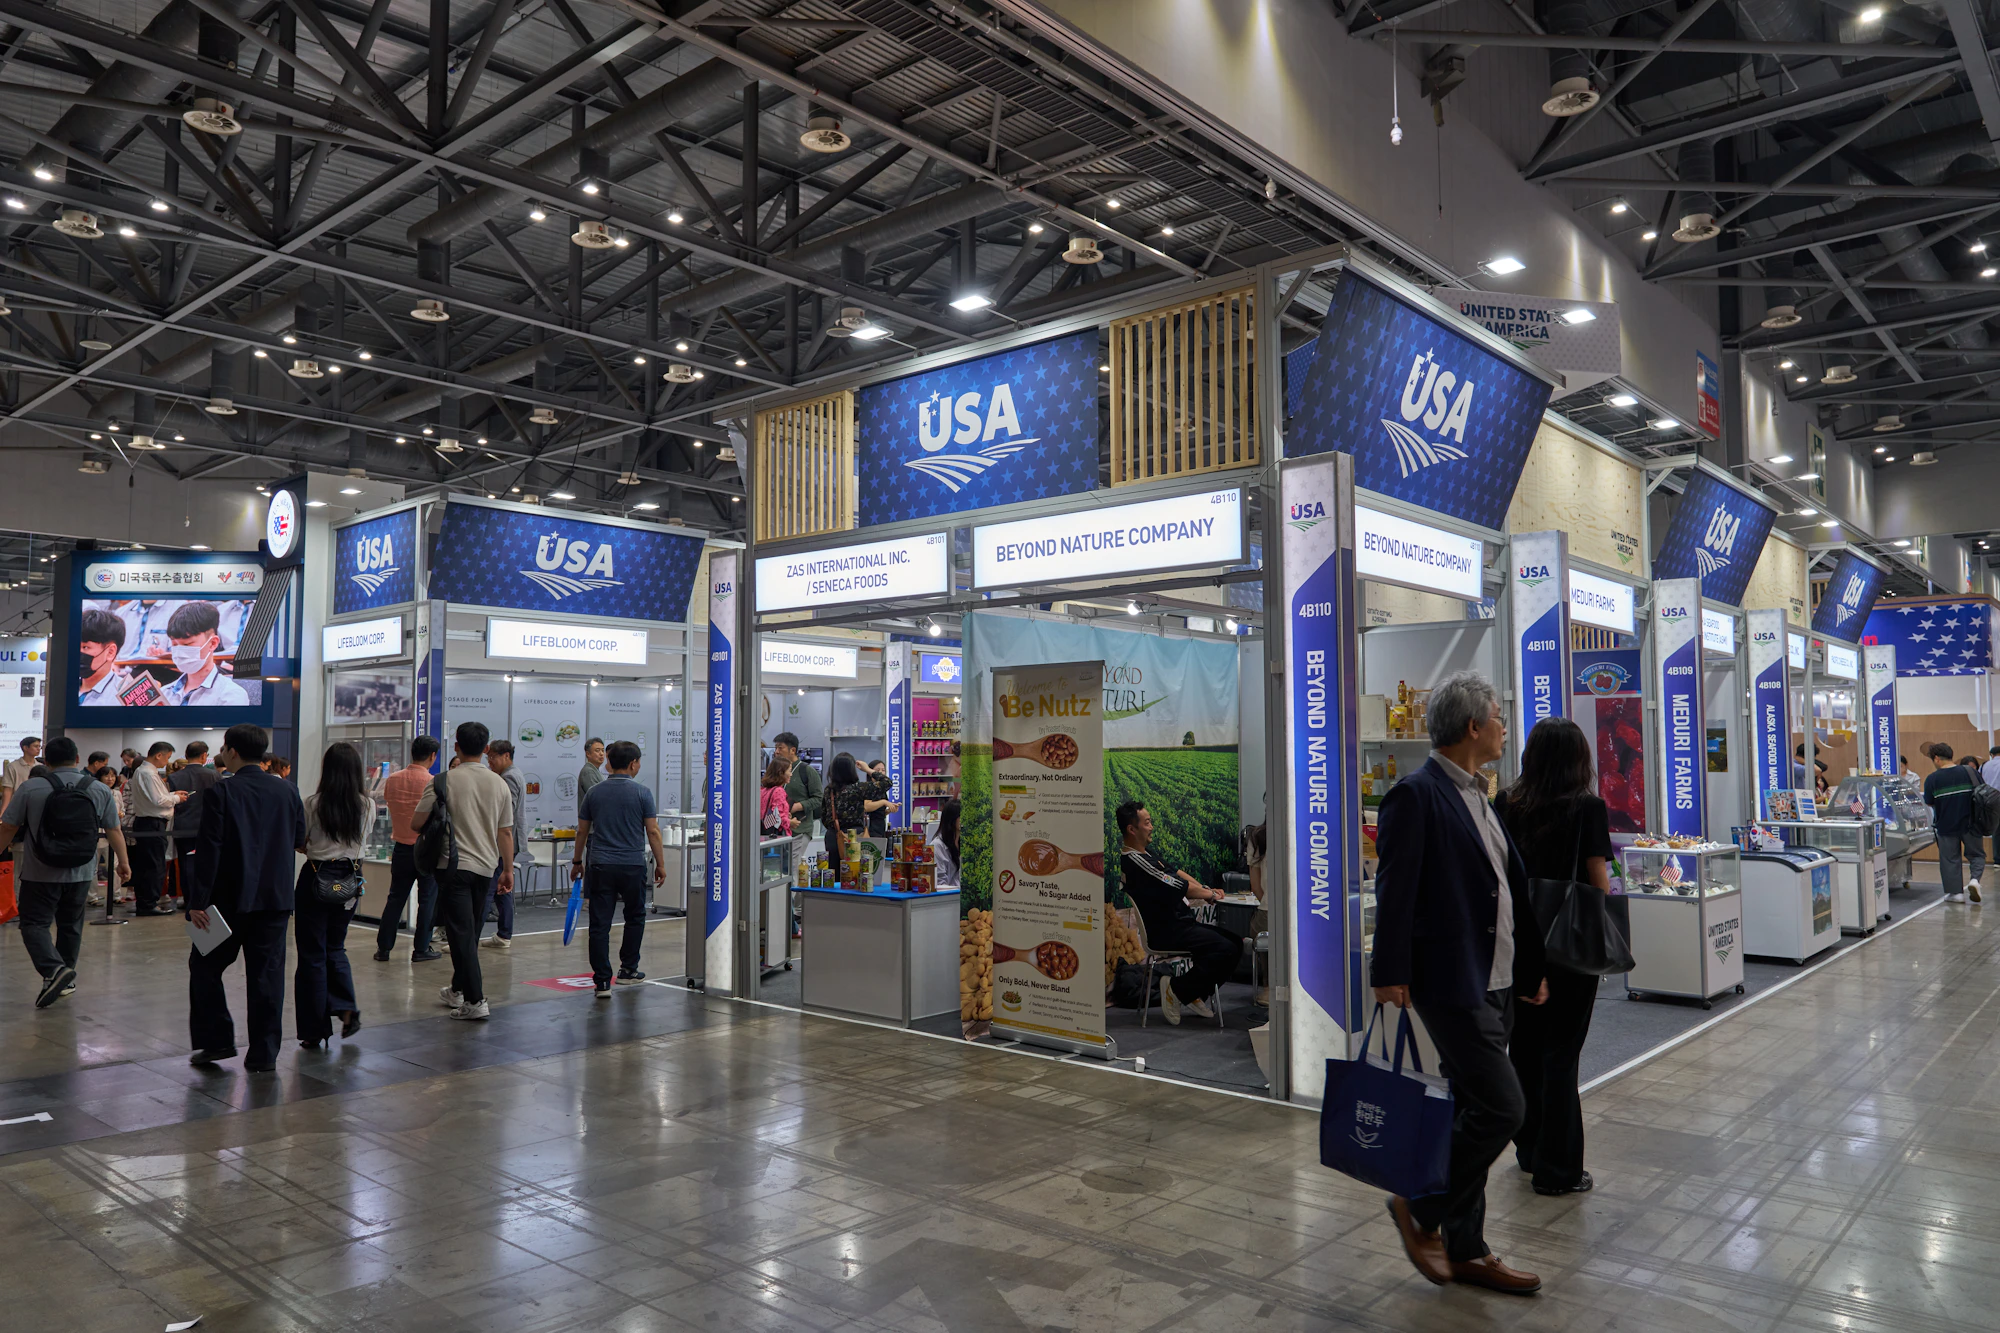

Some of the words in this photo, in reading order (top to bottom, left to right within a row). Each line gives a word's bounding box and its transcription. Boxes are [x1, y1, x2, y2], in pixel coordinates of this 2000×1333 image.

[1460, 302, 1516, 319] UNITED
[1519, 307, 1550, 322] STAT
[1401, 350, 1474, 444] USA
[918, 383, 1022, 452] USA
[1210, 492, 1237, 505] 4B110
[1290, 502, 1326, 520] USA
[1611, 530, 1625, 543] UNITED
[1625, 534, 1639, 548] STATES
[1704, 502, 1741, 556] USA
[926, 535, 945, 545] 4B101
[996, 539, 1057, 562] BEYOND
[1060, 530, 1124, 554] NATURE
[1128, 517, 1214, 545] COMPANY
[356, 534, 394, 572] USA
[534, 532, 614, 578] USA
[1364, 531, 1400, 557] BEYOND
[1401, 541, 1434, 565] NATURE
[1435, 550, 1472, 574] COMPANY
[786, 564, 805, 578] ZAS
[806, 553, 887, 575] INTERNATIONAL
[889, 550, 910, 565] INC.
[1519, 565, 1550, 578] USA
[119, 571, 204, 584] 미국육류수출협회
[714, 582, 732, 593] USA
[806, 581, 811, 596] /
[812, 578, 852, 594] SENECA
[854, 573, 888, 590] FOODS
[1571, 587, 1595, 607] MEDURI
[1595, 594, 1616, 613] FARMS
[1842, 574, 1866, 608] USA
[1299, 602, 1332, 617] 4B110
[1661, 607, 1687, 617] USA
[418, 625, 428, 634] USA
[1753, 632, 1776, 641] USA
[337, 634, 369, 649] LIFEBLOOM
[369, 632, 386, 645] CORP.
[523, 635, 586, 649] LIFEBLOOM
[588, 638, 618, 652] CORP.
[1527, 639, 1555, 652] 4B110
[711, 651, 728, 662] 4B101
[764, 652, 812, 664] LIFEBLOOM
[813, 655, 836, 667] CORP.
[1869, 662, 1888, 670] USA
[931, 664, 961, 677] SUNSWEET
[1103, 665, 1143, 685] YOND
[1584, 664, 1605, 675] MEDURI
[1606, 664, 1623, 676] FARMS
[1667, 666, 1694, 676] 4B109
[124, 680, 152, 705] AMERICAN
[714, 683, 723, 705] ZAS
[1007, 679, 1053, 696] Welcome
[1057, 676, 1068, 690] to
[1306, 650, 1325, 729] BEYOND
[1758, 681, 1782, 690] 4B108
[135, 693, 149, 706] BEEF
[1007, 695, 1035, 718] Be
[1039, 694, 1091, 717] Nutz
[1103, 688, 1146, 712] TURE
[1672, 694, 1691, 751] MEDURI
[1766, 704, 1774, 733] ALASKA
[1061, 724, 1077, 734] Peanuts
[1878, 716, 1889, 745] PACIFIC
[713, 708, 723, 789] INTERNATIONAL
[891, 716, 900, 770] LIFEBLOOM
[1767, 733, 1777, 765] SEAFOOD
[1880, 746, 1891, 775] CHEESE
[998, 773, 1041, 783] Extraordinary,
[1054, 774, 1083, 784] Ordinary
[1308, 736, 1329, 814] NATURE
[1674, 757, 1693, 810] FARMS
[1768, 766, 1779, 790] MARKE
[891, 774, 900, 803] CORP.
[713, 822, 723, 864] SENECA
[1024, 830, 1038, 838] Peanut
[1038, 830, 1050, 839] Butter
[1309, 821, 1330, 921] COMPANY
[713, 866, 722, 902] FOODS
[1018, 879, 1040, 890] Savory
[1040, 881, 1060, 890] Taste,
[1039, 890, 1048, 898] No
[1049, 891, 1068, 901] Sugar
[1069, 892, 1091, 901] Added
[1055, 932, 1072, 943] Peanuts
[1708, 922, 1723, 938] UNITED
[1724, 917, 1739, 934] STATES
[1714, 933, 1734, 950] AMERICA
[998, 975, 1013, 986] Only
[1014, 978, 1030, 988] Bold,
[1030, 981, 1050, 991] Never
[1051, 984, 1071, 994] Bland
[1355, 1109, 1385, 1128] 한만두
